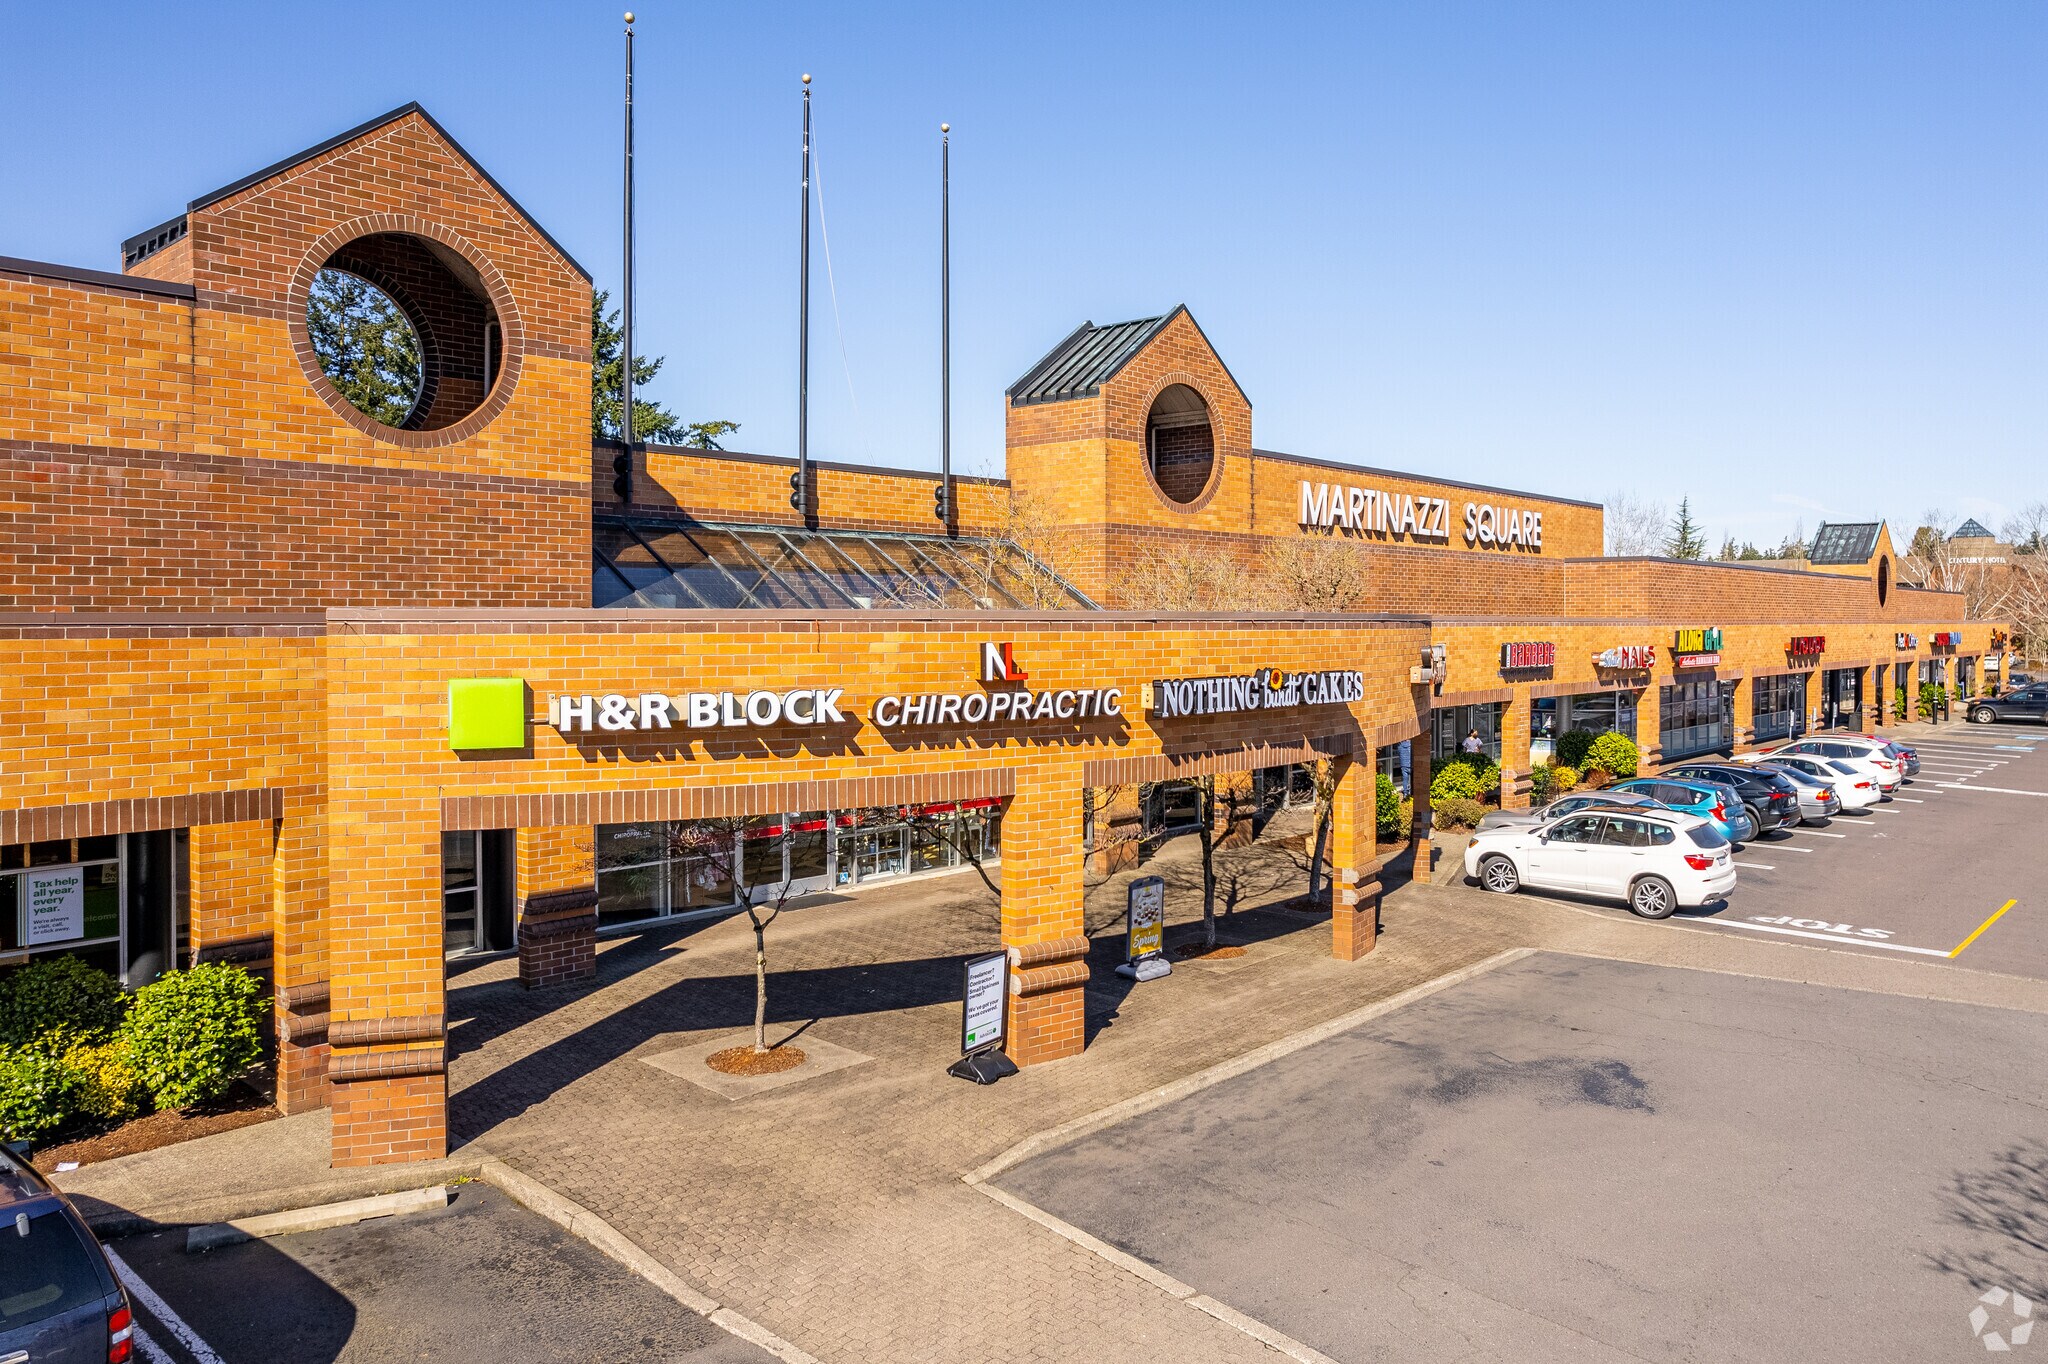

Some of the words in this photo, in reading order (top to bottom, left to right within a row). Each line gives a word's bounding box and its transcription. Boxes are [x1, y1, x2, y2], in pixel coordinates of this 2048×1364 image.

[1299, 480, 1450, 537] MARTINAZZI
[1464, 502, 1542, 547] SQUARE
[1620, 646, 1656, 669] NAILS
[1161, 677, 1260, 717] NOTHING
[1263, 670, 1301, 709] bundt
[1303, 671, 1364, 705] CAKES
[558, 693, 671, 732] H&R
[687, 688, 846, 729] BLOCK
[874, 688, 1122, 727] CHIROPRACTIC
[33, 880, 53, 889] Tax
[54, 877, 79, 886] help
[33, 888, 46, 897] all
[48, 887, 75, 897] year,
[33, 896, 65, 906] every
[33, 906, 60, 916] year.
[1749, 915, 1897, 939] STOP
[1132, 931, 1158, 949] Spring
[969, 985, 982, 995] Small
